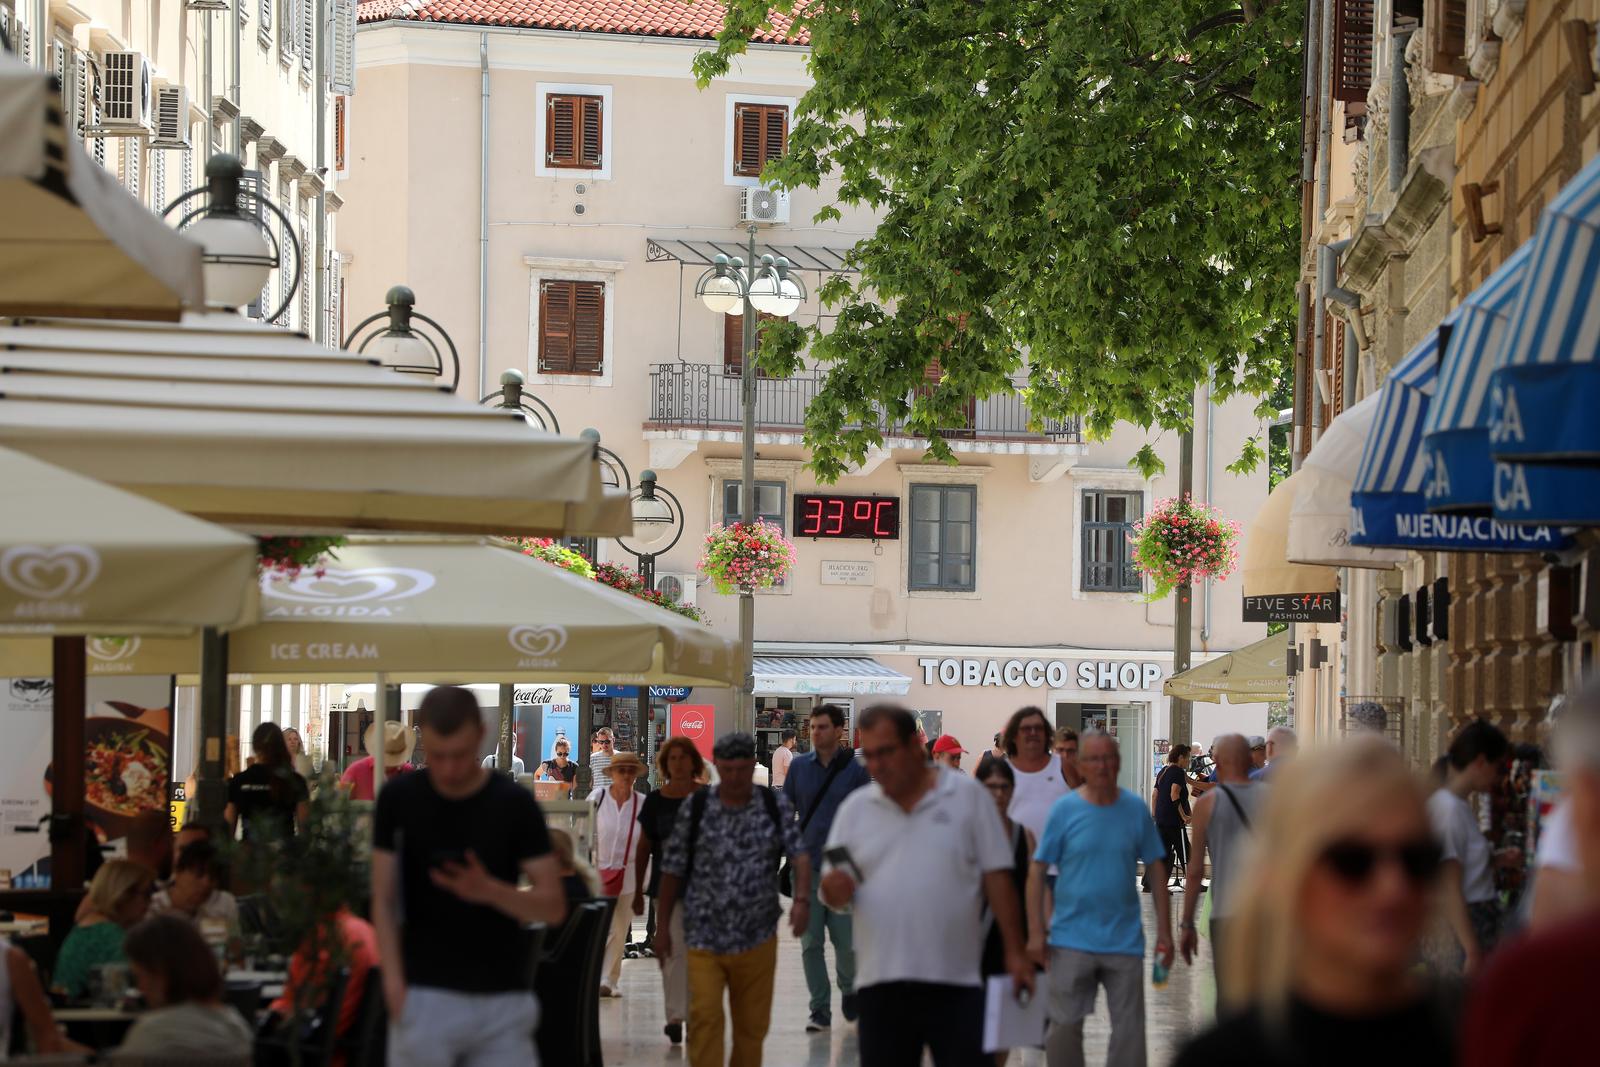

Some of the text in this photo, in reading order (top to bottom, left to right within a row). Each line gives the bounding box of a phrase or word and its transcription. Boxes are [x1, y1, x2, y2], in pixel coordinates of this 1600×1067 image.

[1493, 462, 1531, 511] CA
[267, 606, 393, 617] ALGIDA
[1246, 597, 1332, 611] FIVE STAR
[271, 643, 379, 660] ICE CREAM
[919, 658, 1068, 688] TOBACCO
[1076, 661, 1163, 690] SHOP
[649, 685, 684, 696] Novine
